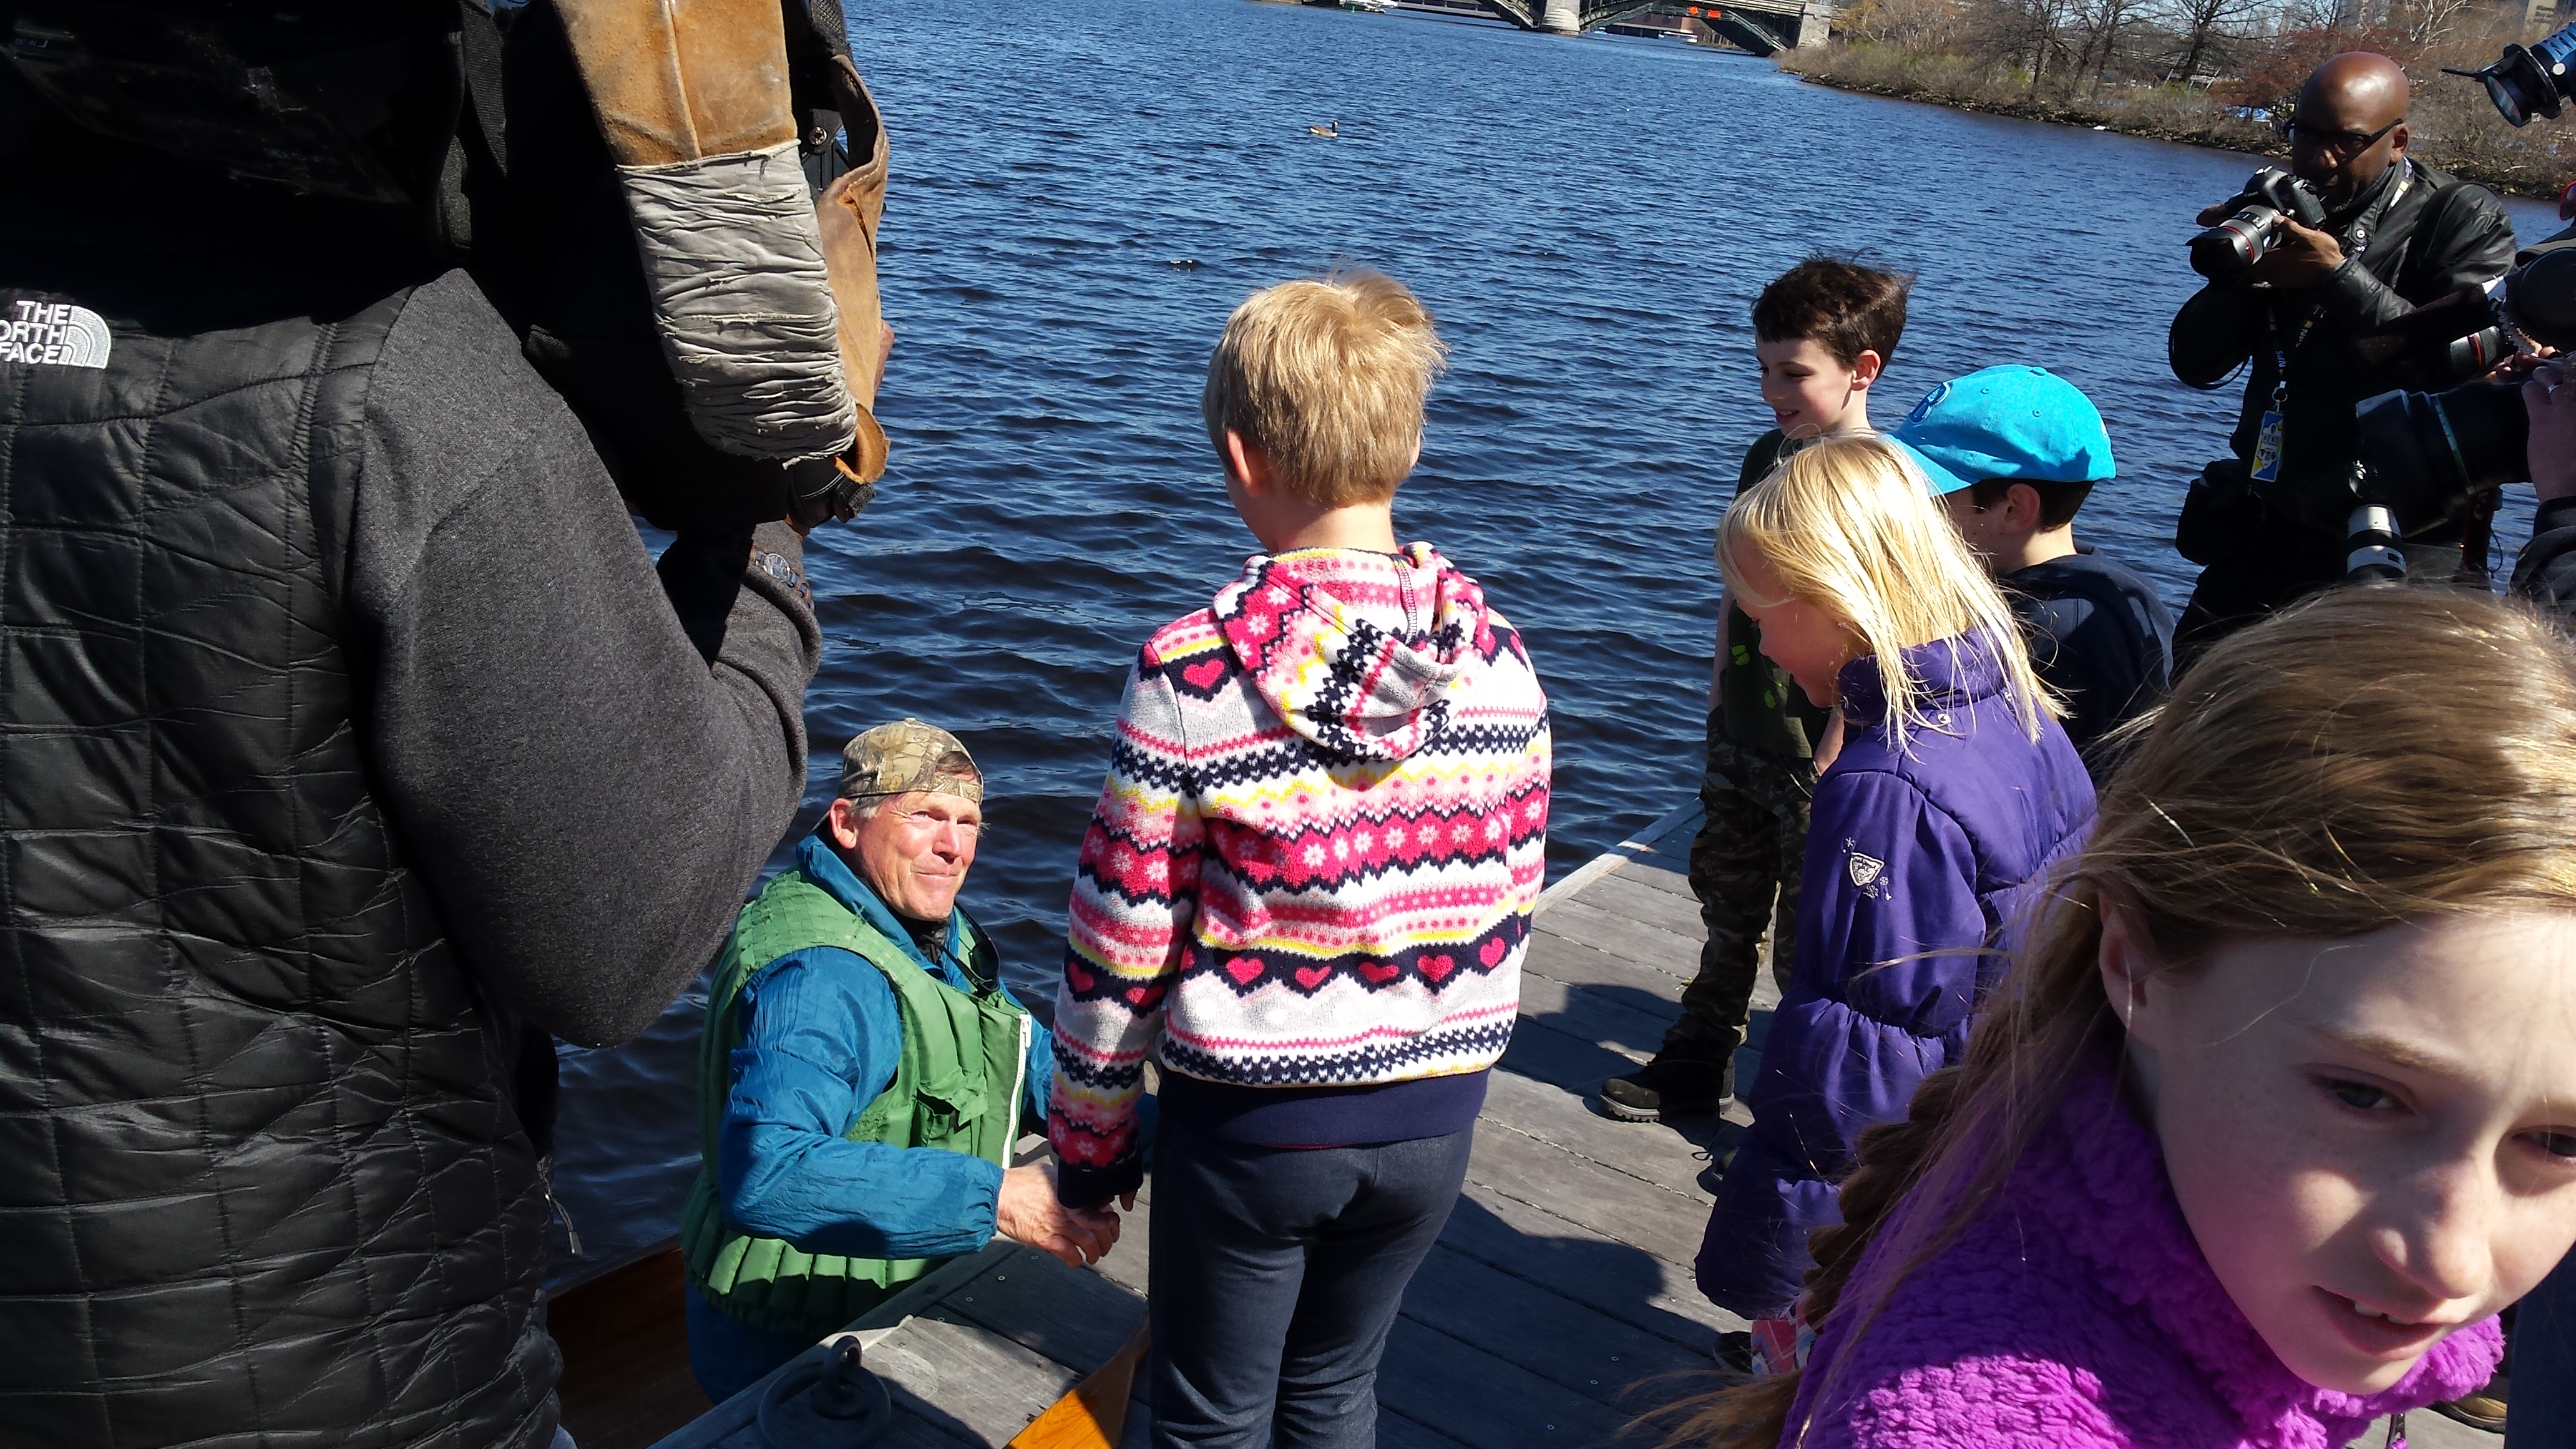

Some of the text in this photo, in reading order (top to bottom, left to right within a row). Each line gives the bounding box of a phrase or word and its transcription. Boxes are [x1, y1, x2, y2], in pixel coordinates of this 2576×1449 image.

[16, 300, 71, 324] THE
[0, 320, 67, 345] ORTH
[2275, 351, 2286, 368] NPS
